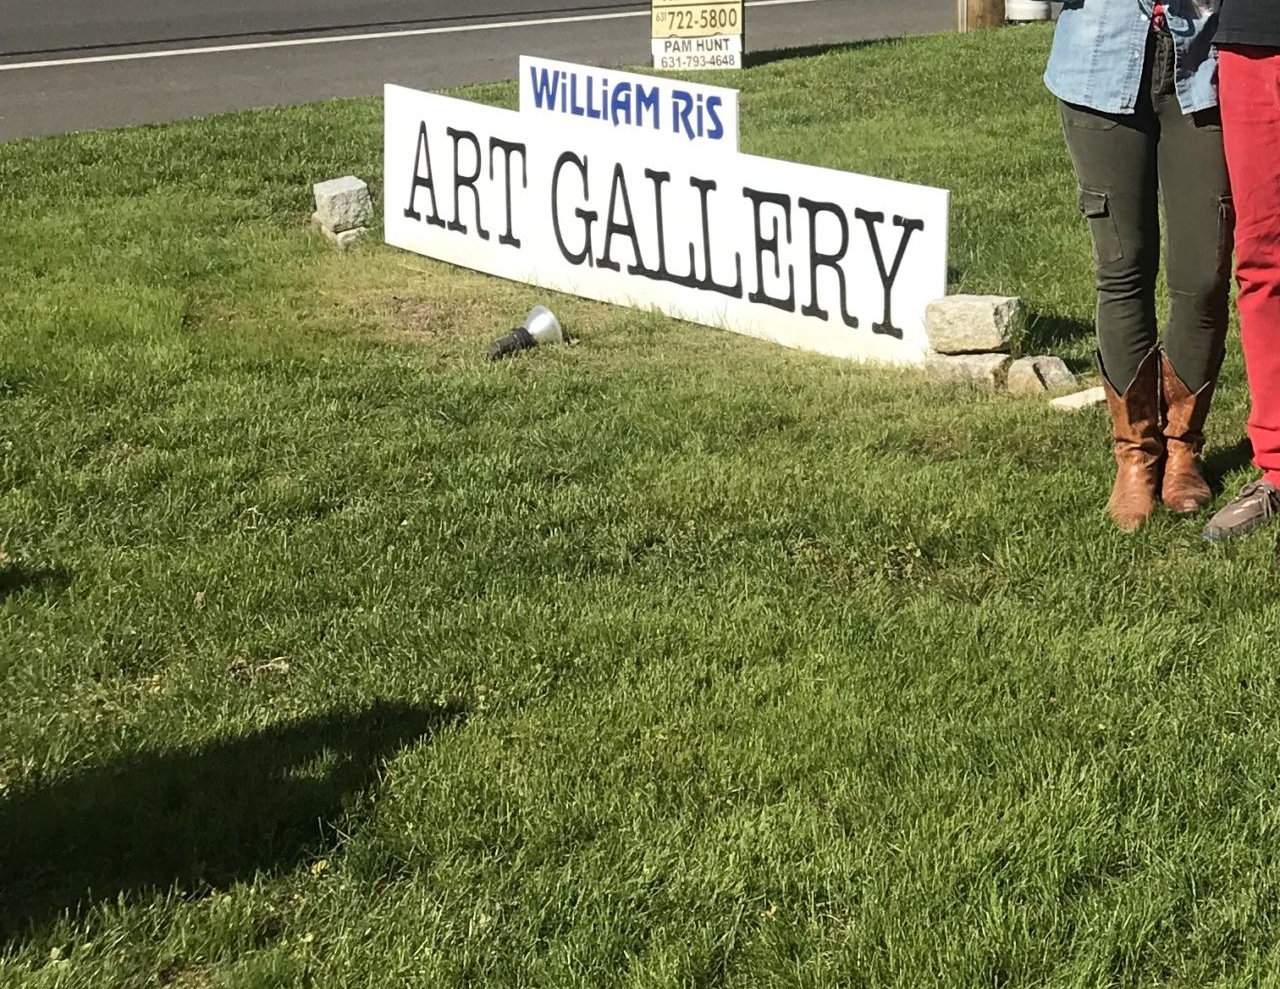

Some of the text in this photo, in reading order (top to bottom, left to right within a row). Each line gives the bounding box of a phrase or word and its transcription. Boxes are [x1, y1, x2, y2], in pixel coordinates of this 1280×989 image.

[655, 8, 738, 30] 631 722-5800
[664, 38, 730, 53] PAM HUNT
[660, 54, 736, 68] 631-793-4648
[404, 120, 925, 339] ART GALLERY
